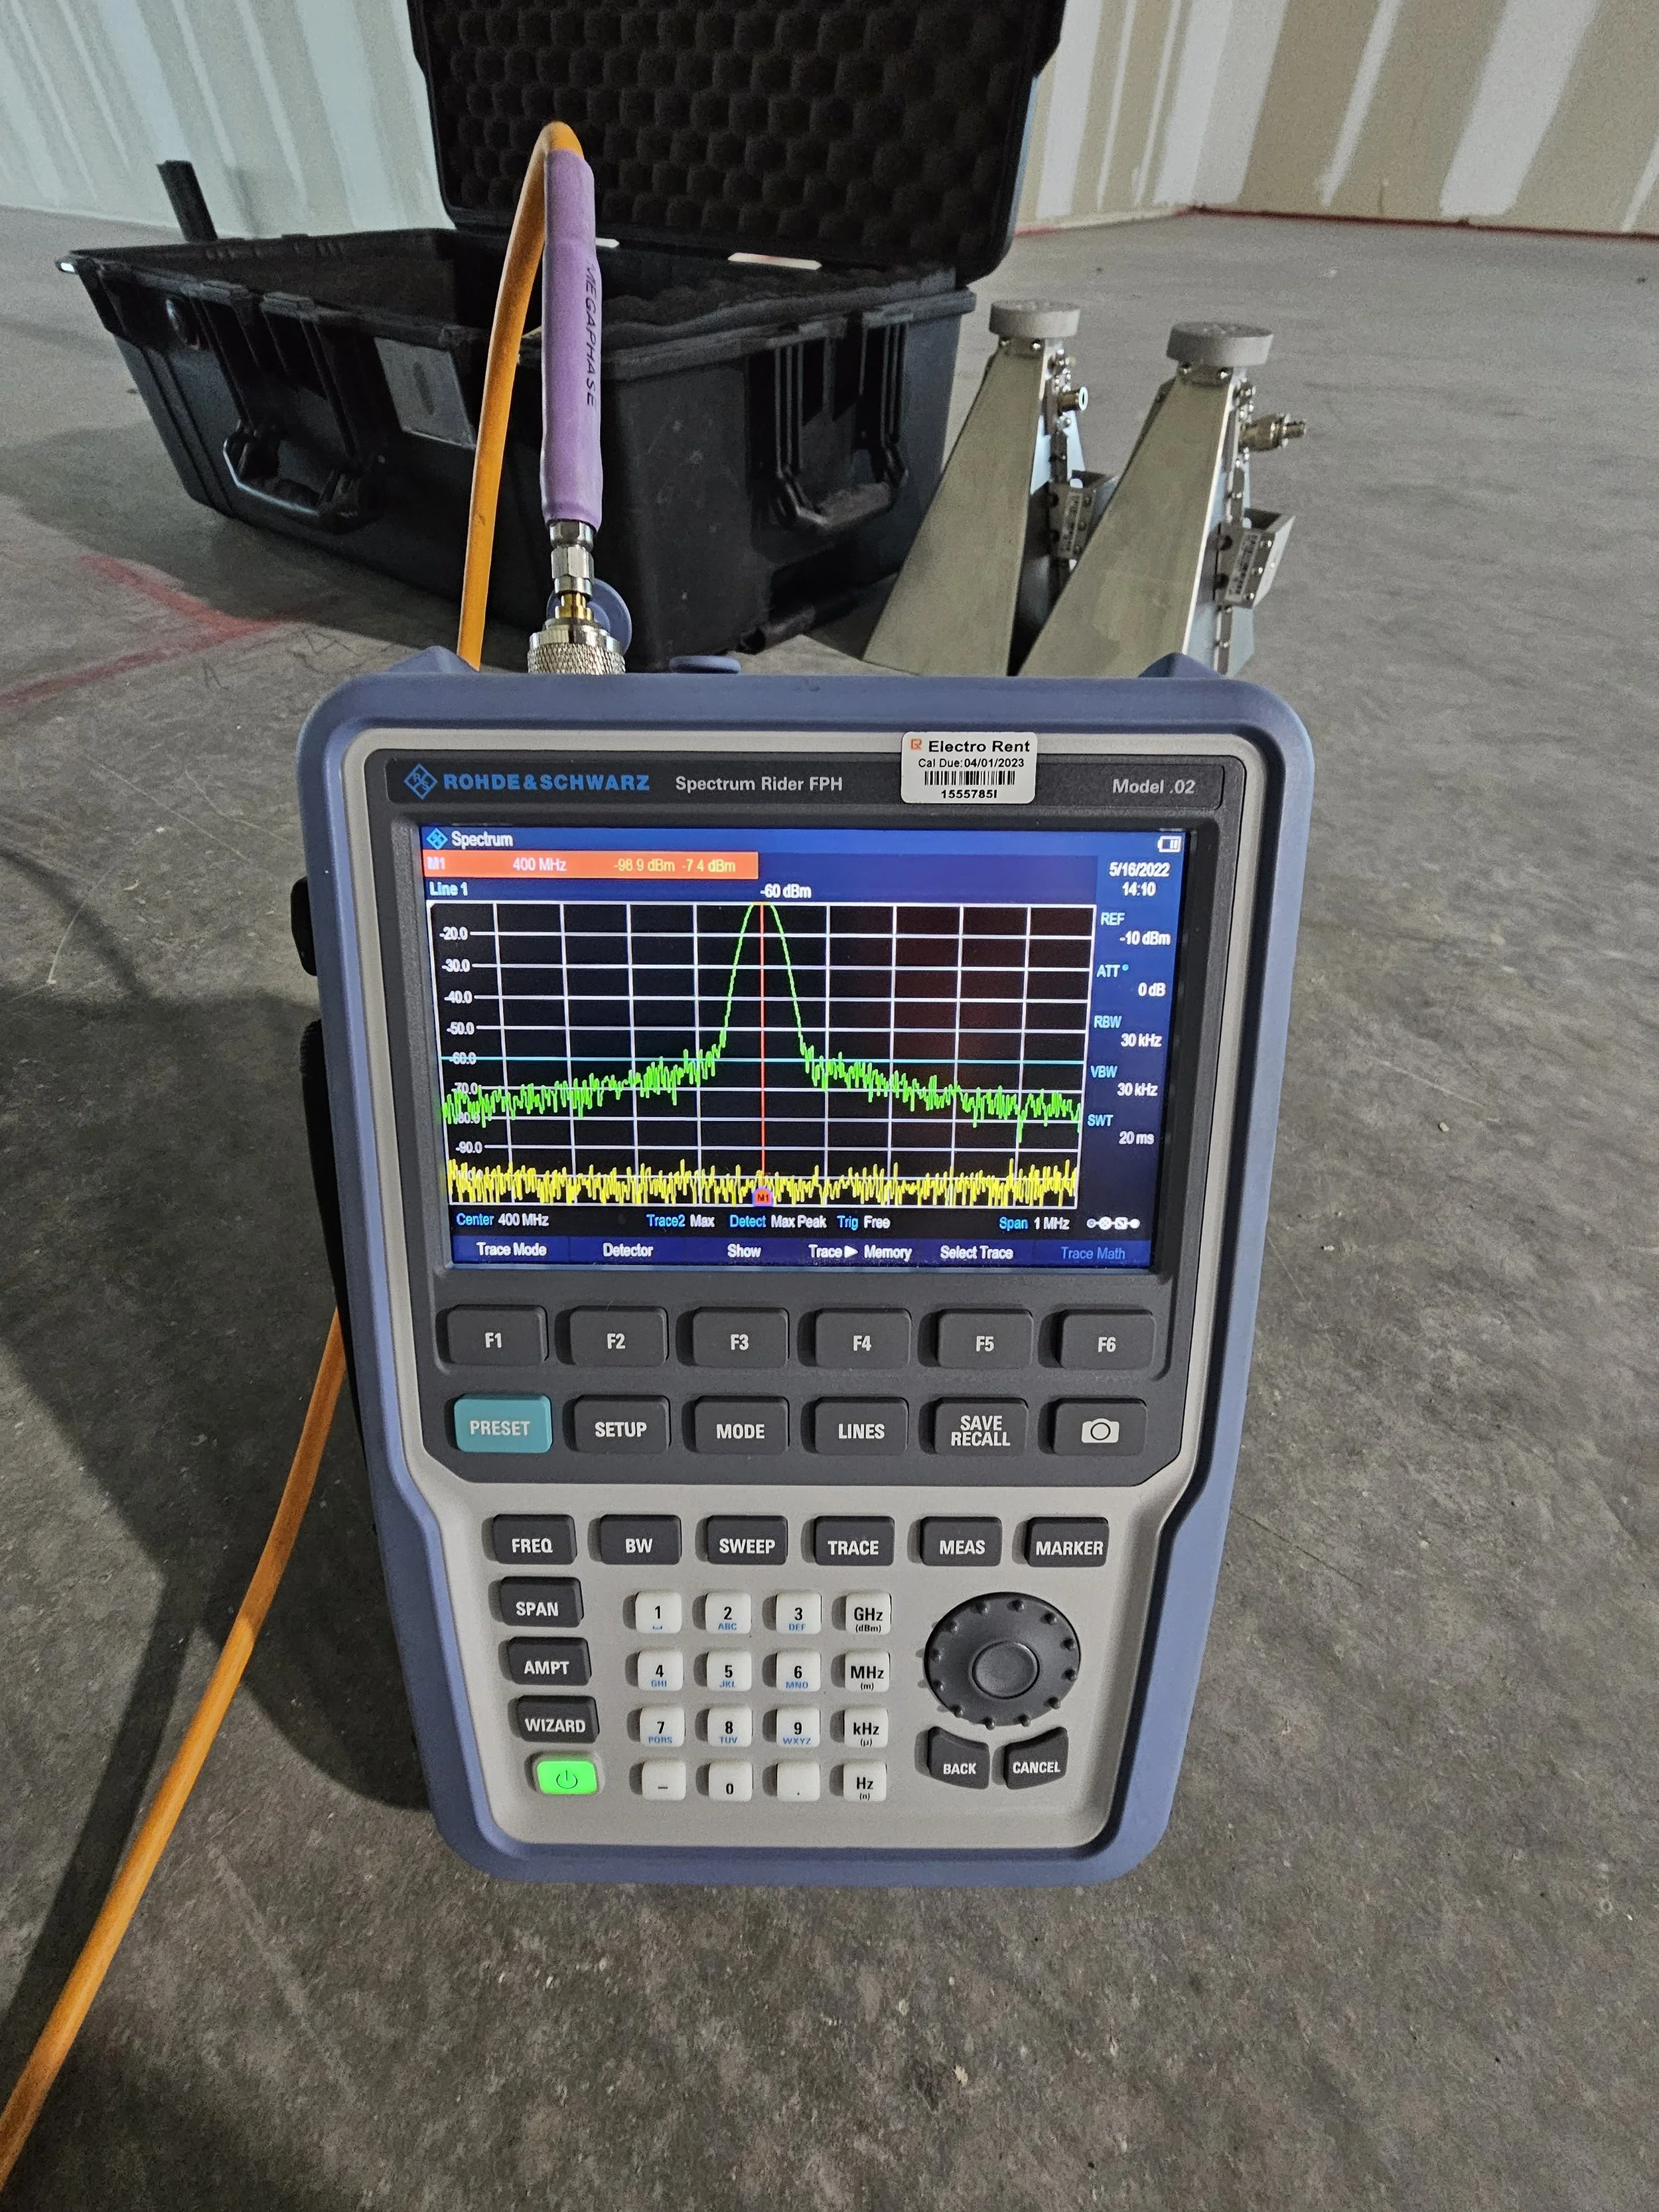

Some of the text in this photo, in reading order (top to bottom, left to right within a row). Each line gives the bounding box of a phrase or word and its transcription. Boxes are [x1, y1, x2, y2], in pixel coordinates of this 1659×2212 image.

[586, 262, 597, 409] MEGAPHASE
[929, 741, 1030, 752] Electro Rent
[918, 759, 1025, 768] Cal Due: 04/01/2023
[444, 773, 650, 791] ROHDE&SCHWARZ
[676, 776, 843, 792] Spectrum Rider FPH
[1113, 778, 1196, 794] Model .02
[451, 831, 513, 849] Spectrum
[427, 857, 445, 870] M1
[513, 858, 536, 871] 400
[540, 858, 567, 871] MHz
[648, 858, 676, 872] dBm
[707, 859, 736, 873] dBm
[1109, 861, 1171, 877] 5/16/2022
[429, 881, 812, 899] Line 1 -60 dBm
[1122, 881, 1156, 896] 14:10
[1101, 913, 1125, 926] REF
[439, 927, 468, 940] -20.0
[1119, 930, 1171, 945] -10 dBm
[441, 959, 470, 972] -30.0
[1097, 964, 1119, 978] ATT
[1138, 983, 1166, 996] 0 dB
[444, 991, 472, 1003] -40.0
[446, 1022, 474, 1035] -50.0
[1094, 1015, 1121, 1029] RBW
[1121, 1034, 1162, 1048] 30 kHz
[449, 1052, 477, 1065] -60.0
[1091, 1065, 1118, 1078] VBW
[1118, 1083, 1158, 1097] 30 kHz
[455, 1112, 480, 1124] 80.0
[1087, 1114, 1114, 1127] SWT
[1119, 1132, 1155, 1145] 20 ms
[455, 1141, 482, 1153] -90.0
[757, 1194, 770, 1203] M1
[457, 1213, 549, 1227] Center 400 MHz
[646, 1215, 891, 1231] Trace2 Max Detect Max Peak Trig Free
[999, 1217, 1070, 1232] Span 1 MHz
[476, 1242, 547, 1256] Trace Mode
[603, 1243, 654, 1258] Detector
[727, 1244, 761, 1258] Show
[808, 1244, 912, 1260] Trace Memory
[940, 1245, 1013, 1260] Select Trace
[1061, 1246, 1125, 1260] Trace Math
[485, 1333, 502, 1348] F1
[607, 1333, 626, 1349] F2
[730, 1335, 749, 1351] F3
[853, 1335, 871, 1351] F4
[975, 1336, 995, 1352] F5
[1098, 1337, 1116, 1353] F6
[470, 1420, 530, 1436] PRESET
[595, 1422, 647, 1438] SETUP
[960, 1416, 1003, 1431] SAVE
[716, 1424, 765, 1439] MODE
[838, 1424, 885, 1439] LINES
[951, 1432, 1011, 1447] RECALL
[512, 1538, 553, 1554] FREQ
[625, 1538, 653, 1553] BW
[719, 1538, 776, 1554] SWEEP
[828, 1540, 879, 1556] TRACE
[939, 1540, 985, 1556] MEAS
[1036, 1541, 1104, 1556] MARKER
[516, 1601, 559, 1617] SPAN
[654, 1605, 661, 1619] 1
[723, 1606, 733, 1620] 2
[794, 1607, 803, 1621] 3
[854, 1607, 883, 1621] GHz
[855, 1624, 881, 1633] (dBm)
[524, 1661, 569, 1675] AMPT
[655, 1664, 664, 1678] 4
[725, 1665, 733, 1678] 5
[794, 1666, 802, 1679] 6
[851, 1666, 884, 1679] MHz
[524, 1718, 586, 1733] WIZARD
[656, 1721, 665, 1734] 7
[725, 1721, 733, 1734] 8
[794, 1722, 802, 1735] 9
[853, 1722, 879, 1735] kHz
[943, 1763, 976, 1775] BACK
[1013, 1761, 1060, 1774] CANCEL
[725, 1783, 734, 1795] 0
[857, 1777, 873, 1789] Hz
